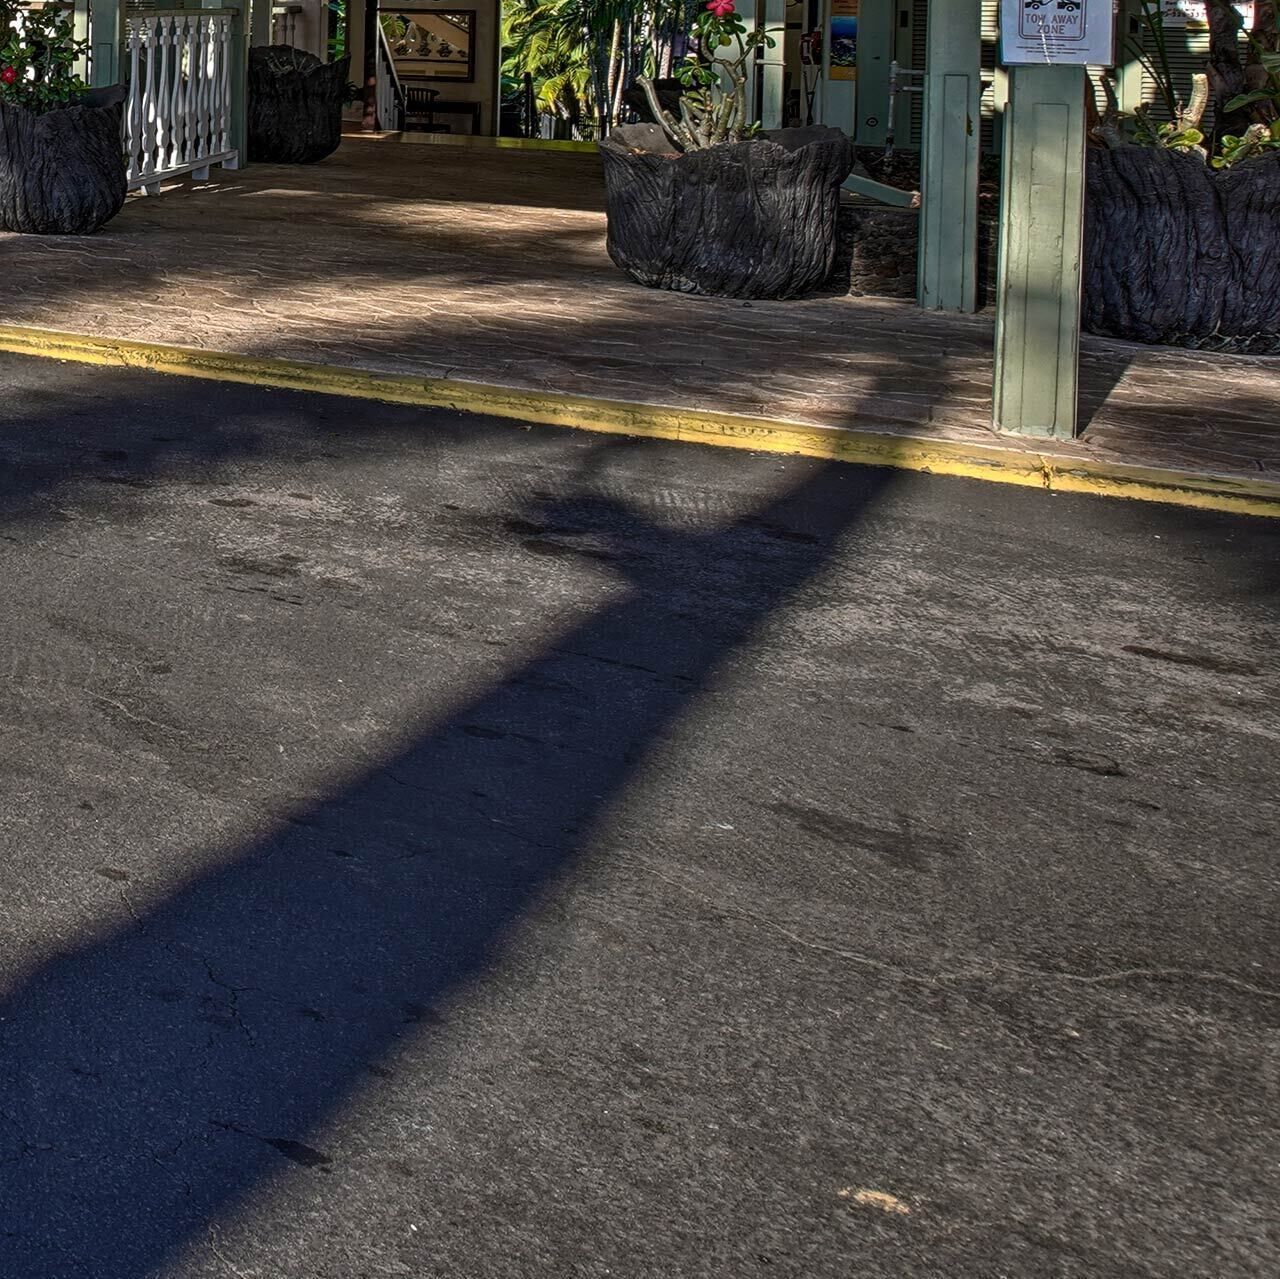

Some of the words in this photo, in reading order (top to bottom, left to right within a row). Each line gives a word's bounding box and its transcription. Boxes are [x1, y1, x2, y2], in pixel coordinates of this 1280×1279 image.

[1025, 13, 1047, 24] TOW
[1051, 14, 1079, 25] AWAY
[1037, 24, 1066, 35] ZONE
